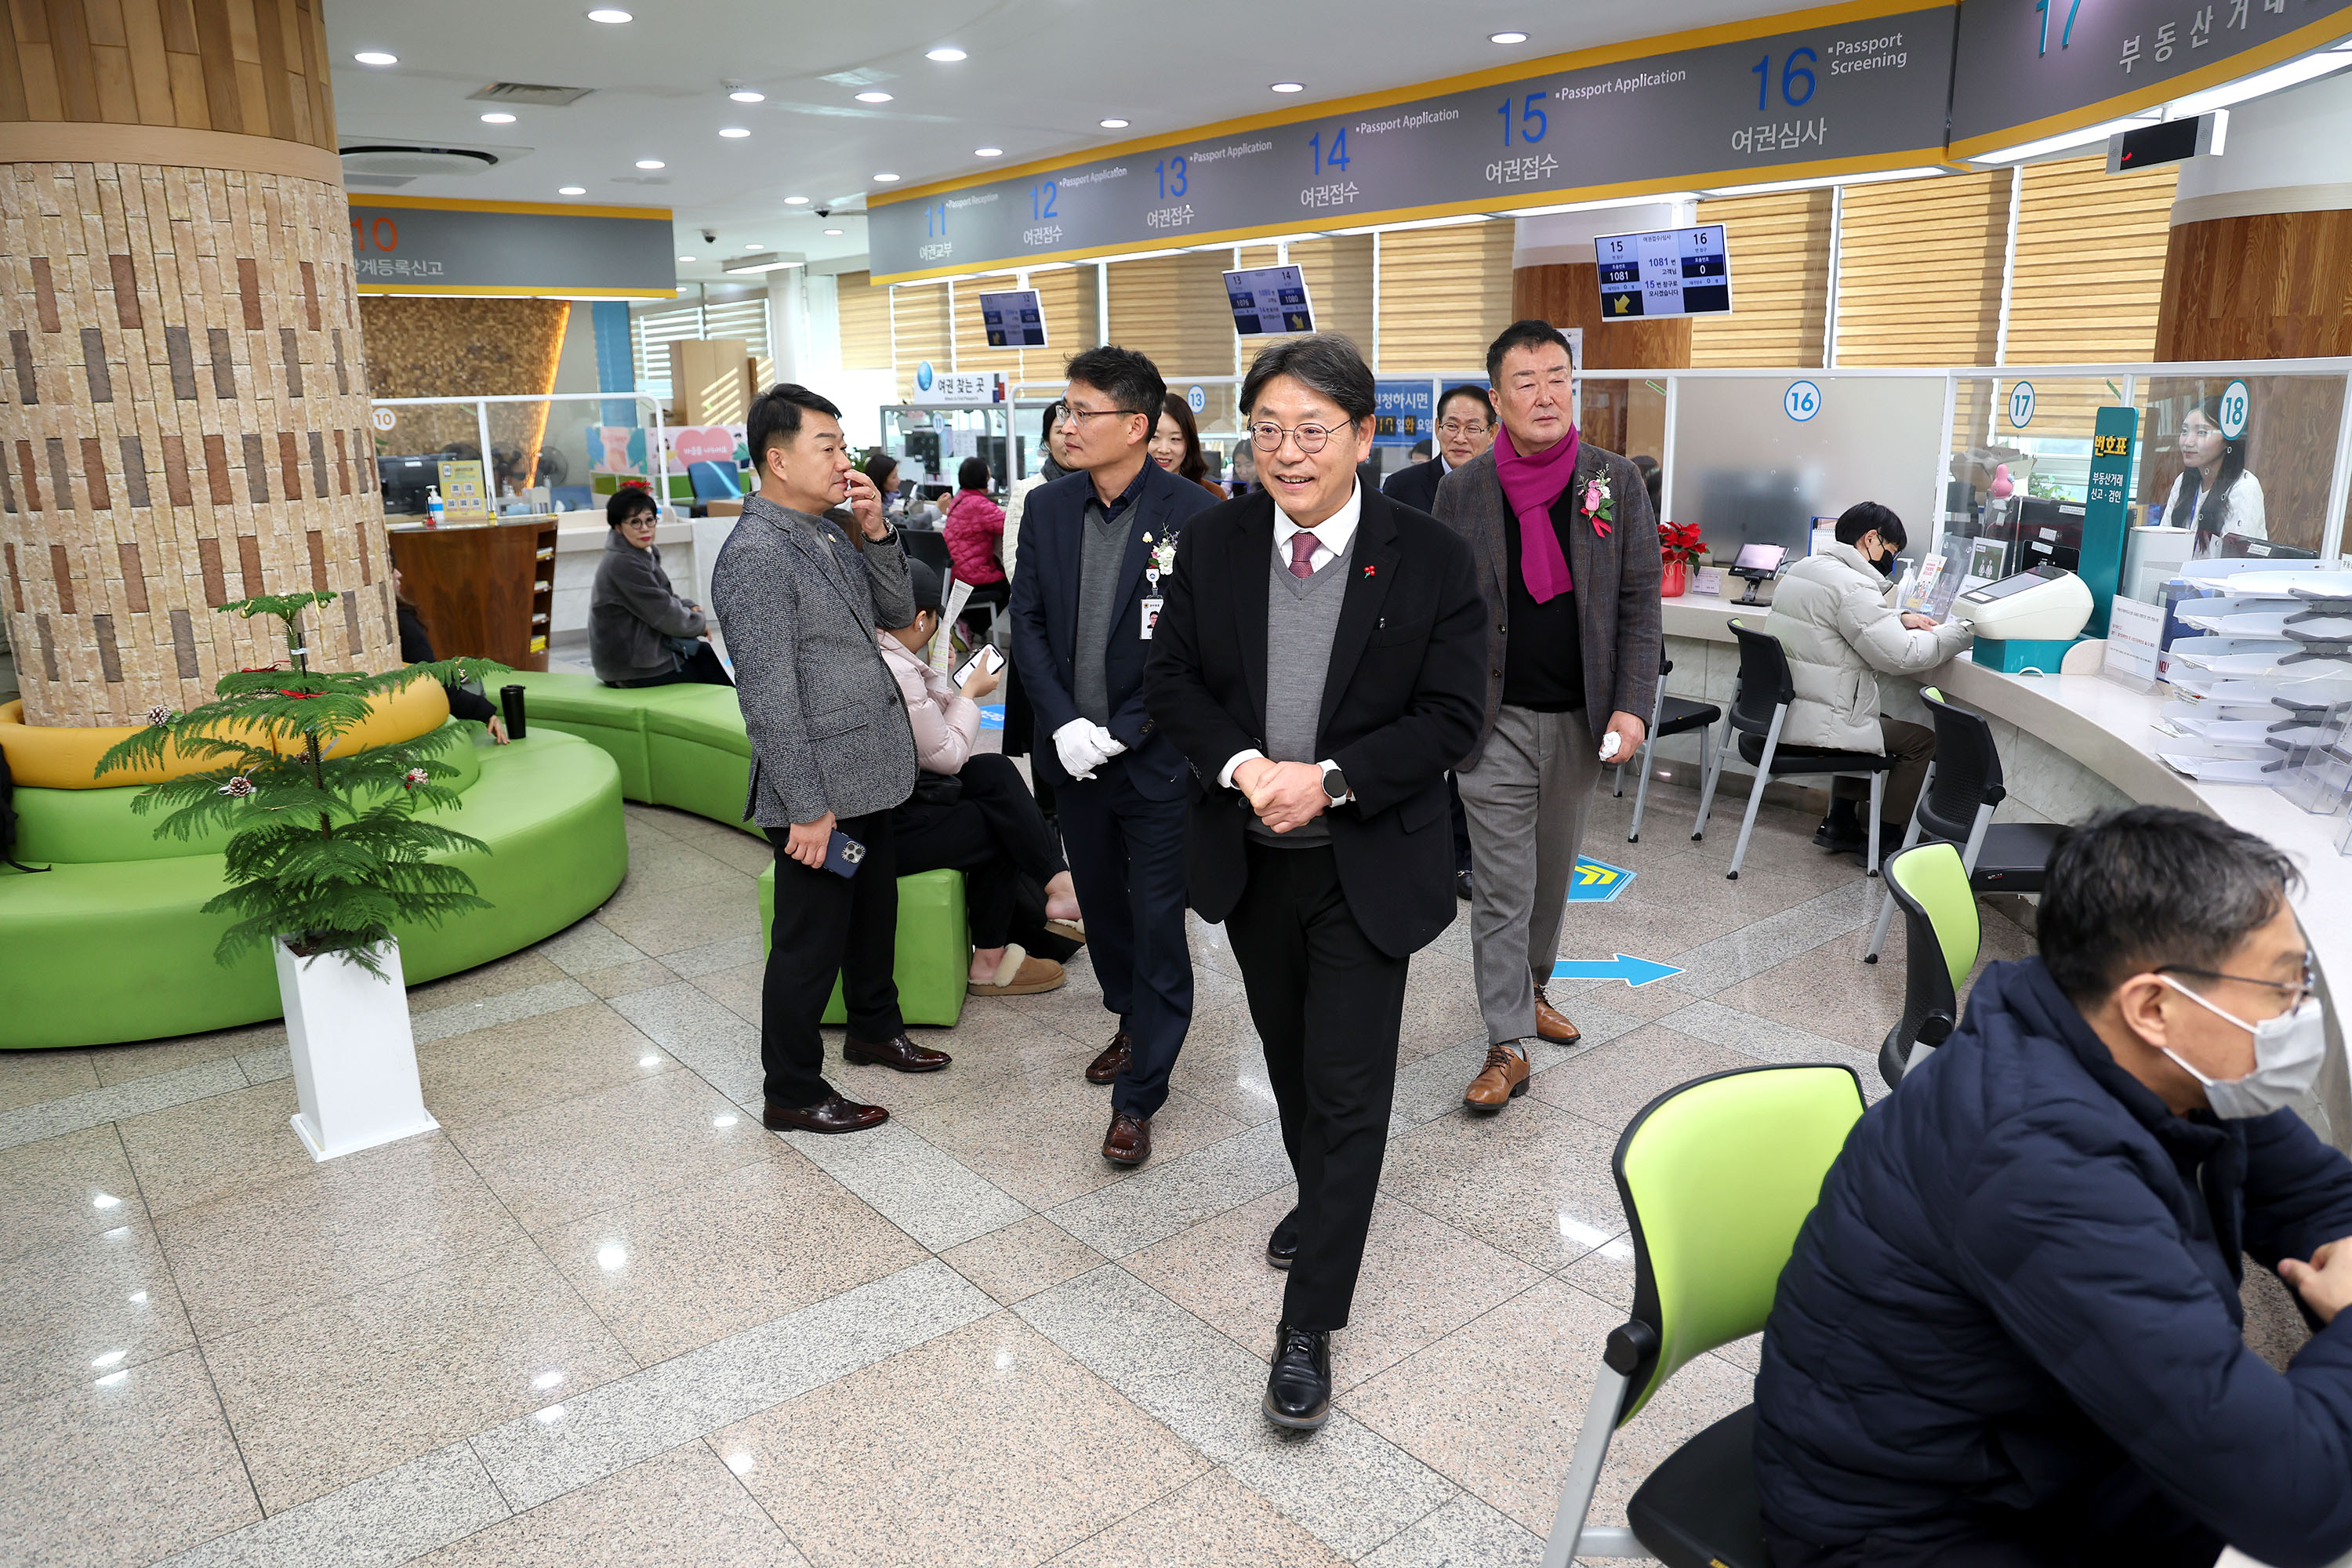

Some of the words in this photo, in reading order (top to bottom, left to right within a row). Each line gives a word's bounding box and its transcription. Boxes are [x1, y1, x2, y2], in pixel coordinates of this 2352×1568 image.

[1836, 32, 1903, 56] Passport
[1831, 52, 1907, 75] Screening
[1562, 81, 1612, 100] Passport
[1614, 69, 1687, 93] Application
[1751, 46, 1817, 111] 16
[1360, 118, 1401, 134] Passport
[1403, 108, 1459, 129] Application
[1497, 91, 1548, 147] 15
[1731, 118, 1828, 154] 여권심사
[1193, 148, 1226, 162] Passport
[1227, 140, 1272, 158] Application
[1308, 127, 1351, 175] 14
[1062, 174, 1090, 187] Passport
[1090, 166, 1127, 182] Application
[1154, 156, 1188, 199] 13
[1486, 153, 1559, 184] 여권접수
[1029, 181, 1058, 220] 12
[1301, 181, 1359, 208] 여권접수
[924, 202, 946, 238] 11
[1147, 205, 1195, 229] 여권접수
[350, 216, 398, 252] 10
[1023, 224, 1063, 245] 여권접수
[1693, 233, 1708, 245] 16
[920, 241, 953, 260] 여권교부
[1610, 241, 1624, 252] 15
[1649, 257, 1668, 267] 1081
[1700, 264, 1705, 274] 0
[1233, 276, 1242, 285] 13
[1283, 271, 1291, 280] 14
[1610, 270, 1628, 281] 1081
[1645, 280, 1655, 289] 15
[938, 378, 953, 394] 여권
[956, 378, 973, 394] 찾는
[976, 377, 984, 393] 곳
[1191, 394, 1202, 407] 13
[1791, 393, 1813, 412] 16
[2015, 394, 2031, 417] 17
[375, 413, 391, 426] 10
[2226, 397, 2244, 426] 18
[2095, 435, 2127, 456] 번호표
[2092, 472, 2123, 487] 부동산거래
[2091, 488, 2103, 500] 신고
[2109, 490, 2121, 503] 검인
